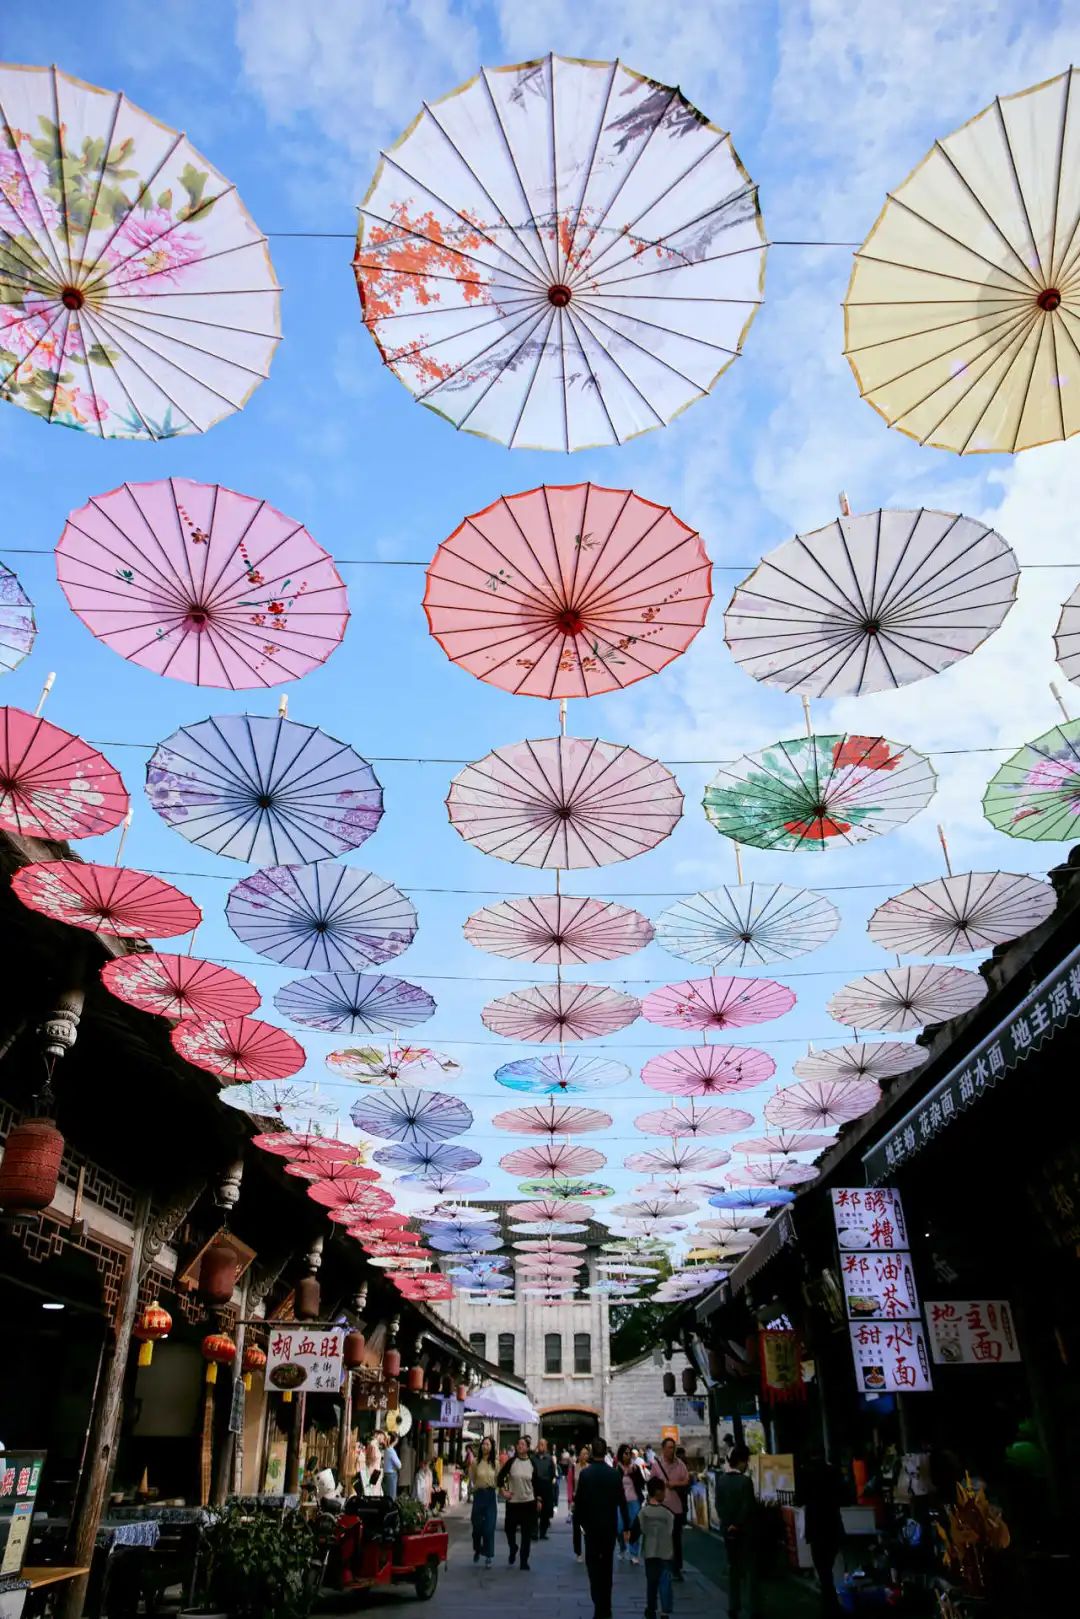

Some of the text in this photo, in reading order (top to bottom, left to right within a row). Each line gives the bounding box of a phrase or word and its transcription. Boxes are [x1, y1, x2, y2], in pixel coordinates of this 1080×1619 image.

[885, 1124, 915, 1165] 地主粉
[918, 1087, 954, 1138] 花杂面
[958, 1039, 1005, 1100] 甜水面
[271, 1333, 341, 1360] 胡血旺
